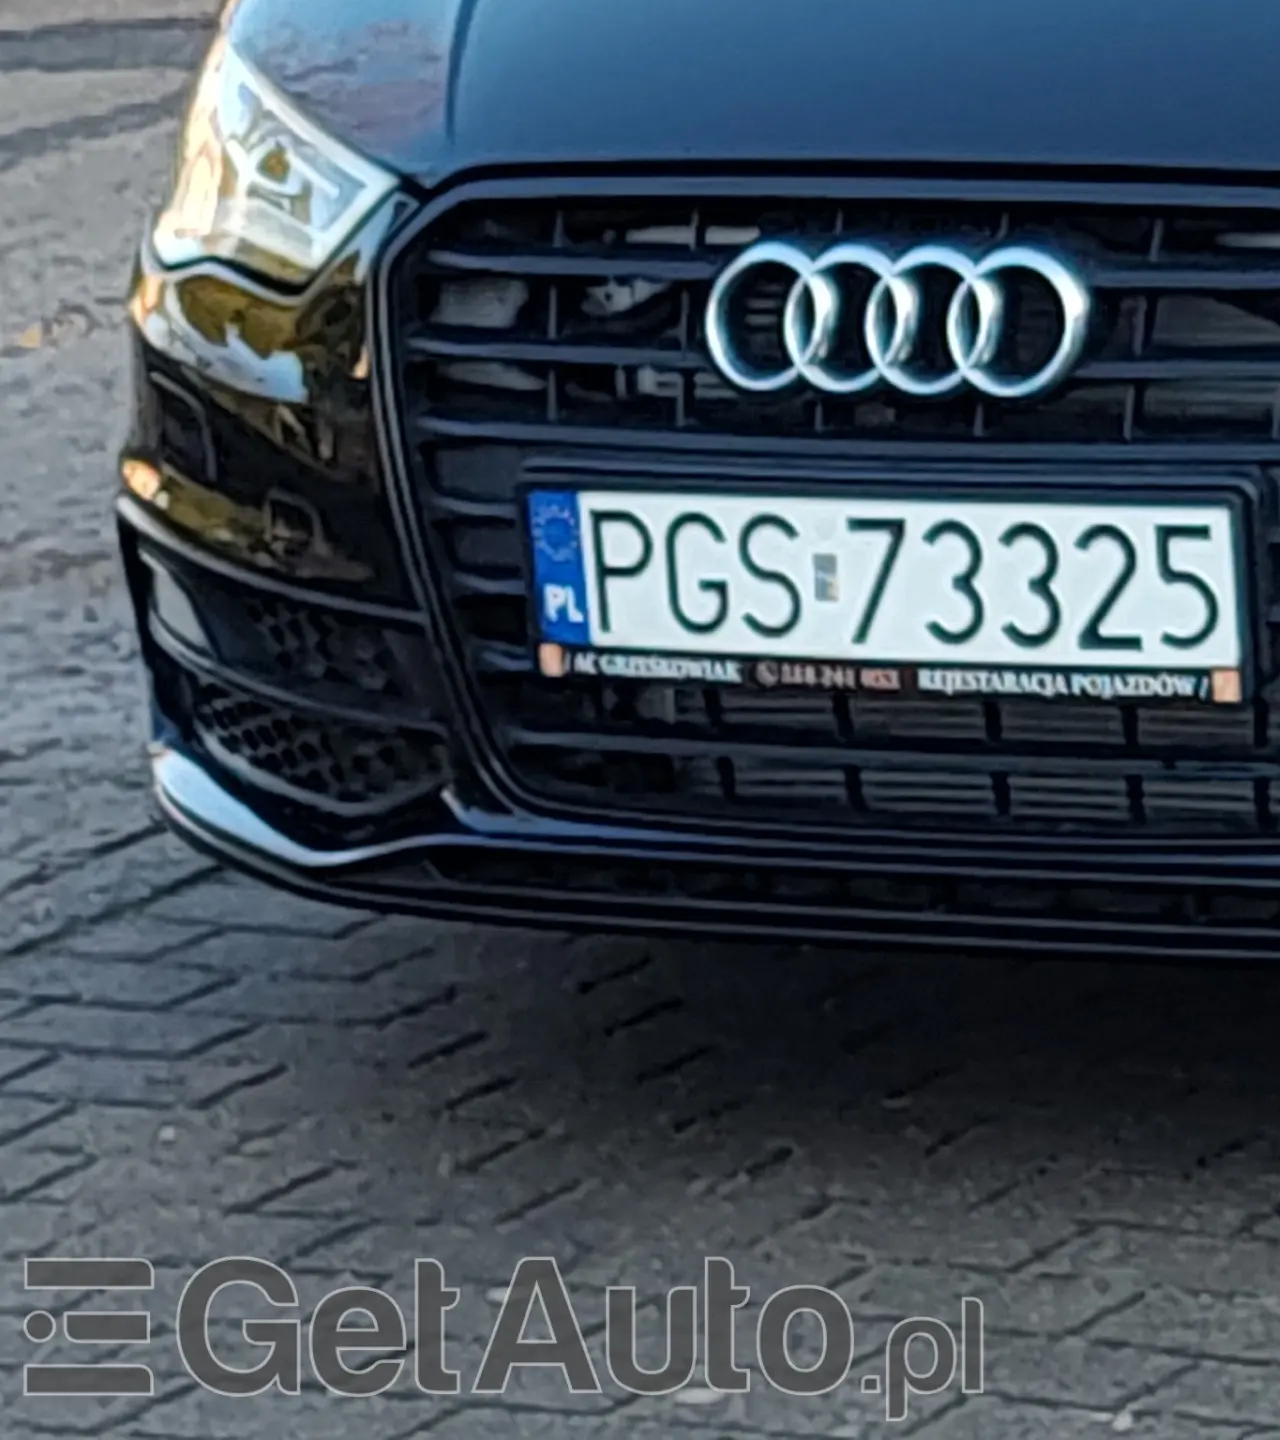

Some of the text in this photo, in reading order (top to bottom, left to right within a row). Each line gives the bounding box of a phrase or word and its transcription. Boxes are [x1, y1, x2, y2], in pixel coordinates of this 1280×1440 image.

[543, 582, 584, 624] PL
[588, 508, 1219, 652] PGS 73325
